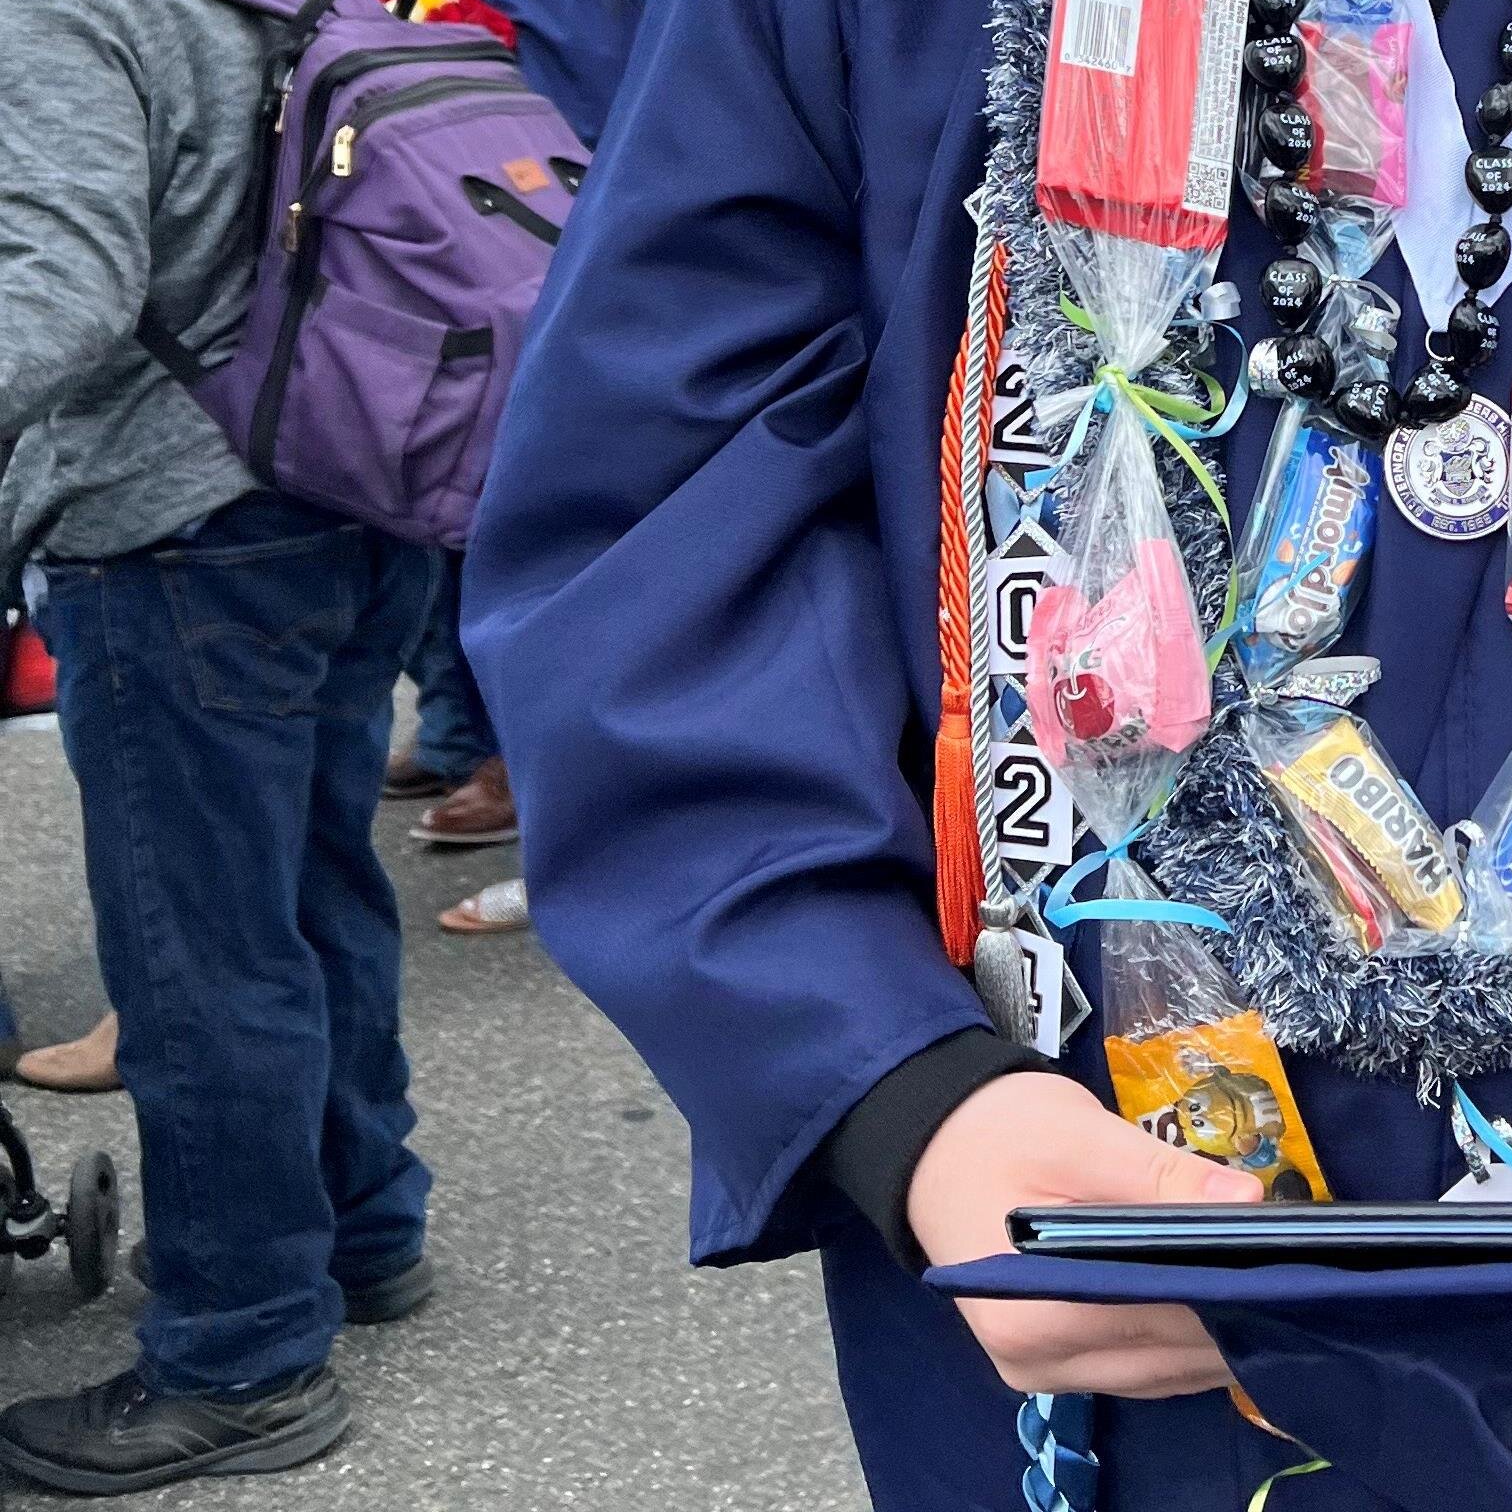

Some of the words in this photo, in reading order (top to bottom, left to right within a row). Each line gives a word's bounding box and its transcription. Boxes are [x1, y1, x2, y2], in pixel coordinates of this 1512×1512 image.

[1255, 36, 1293, 48] CLASS
[1266, 45, 1282, 55] OF
[1263, 54, 1293, 68] 2024
[1280, 112, 1312, 126] CLASS
[1291, 127, 1306, 138] OF
[1287, 140, 1312, 149] 2024
[1486, 171, 1502, 182] OF
[1481, 181, 1512, 192] 2024
[1302, 201, 1315, 213] OF
[1457, 254, 1475, 265] 024
[1269, 270, 1308, 283] CLASS
[1278, 285, 1295, 297] OF
[1272, 296, 1303, 307] 2024
[1284, 367, 1298, 380] OF
[1432, 362, 1459, 392] CLASS
[1427, 373, 1442, 388] OF
[1347, 382, 1363, 409] 2024
[1360, 387, 1373, 402] OF
[1414, 376, 1437, 402] 2024
[1370, 384, 1389, 418] CLASS
[1328, 753, 1447, 898] HARIBO
